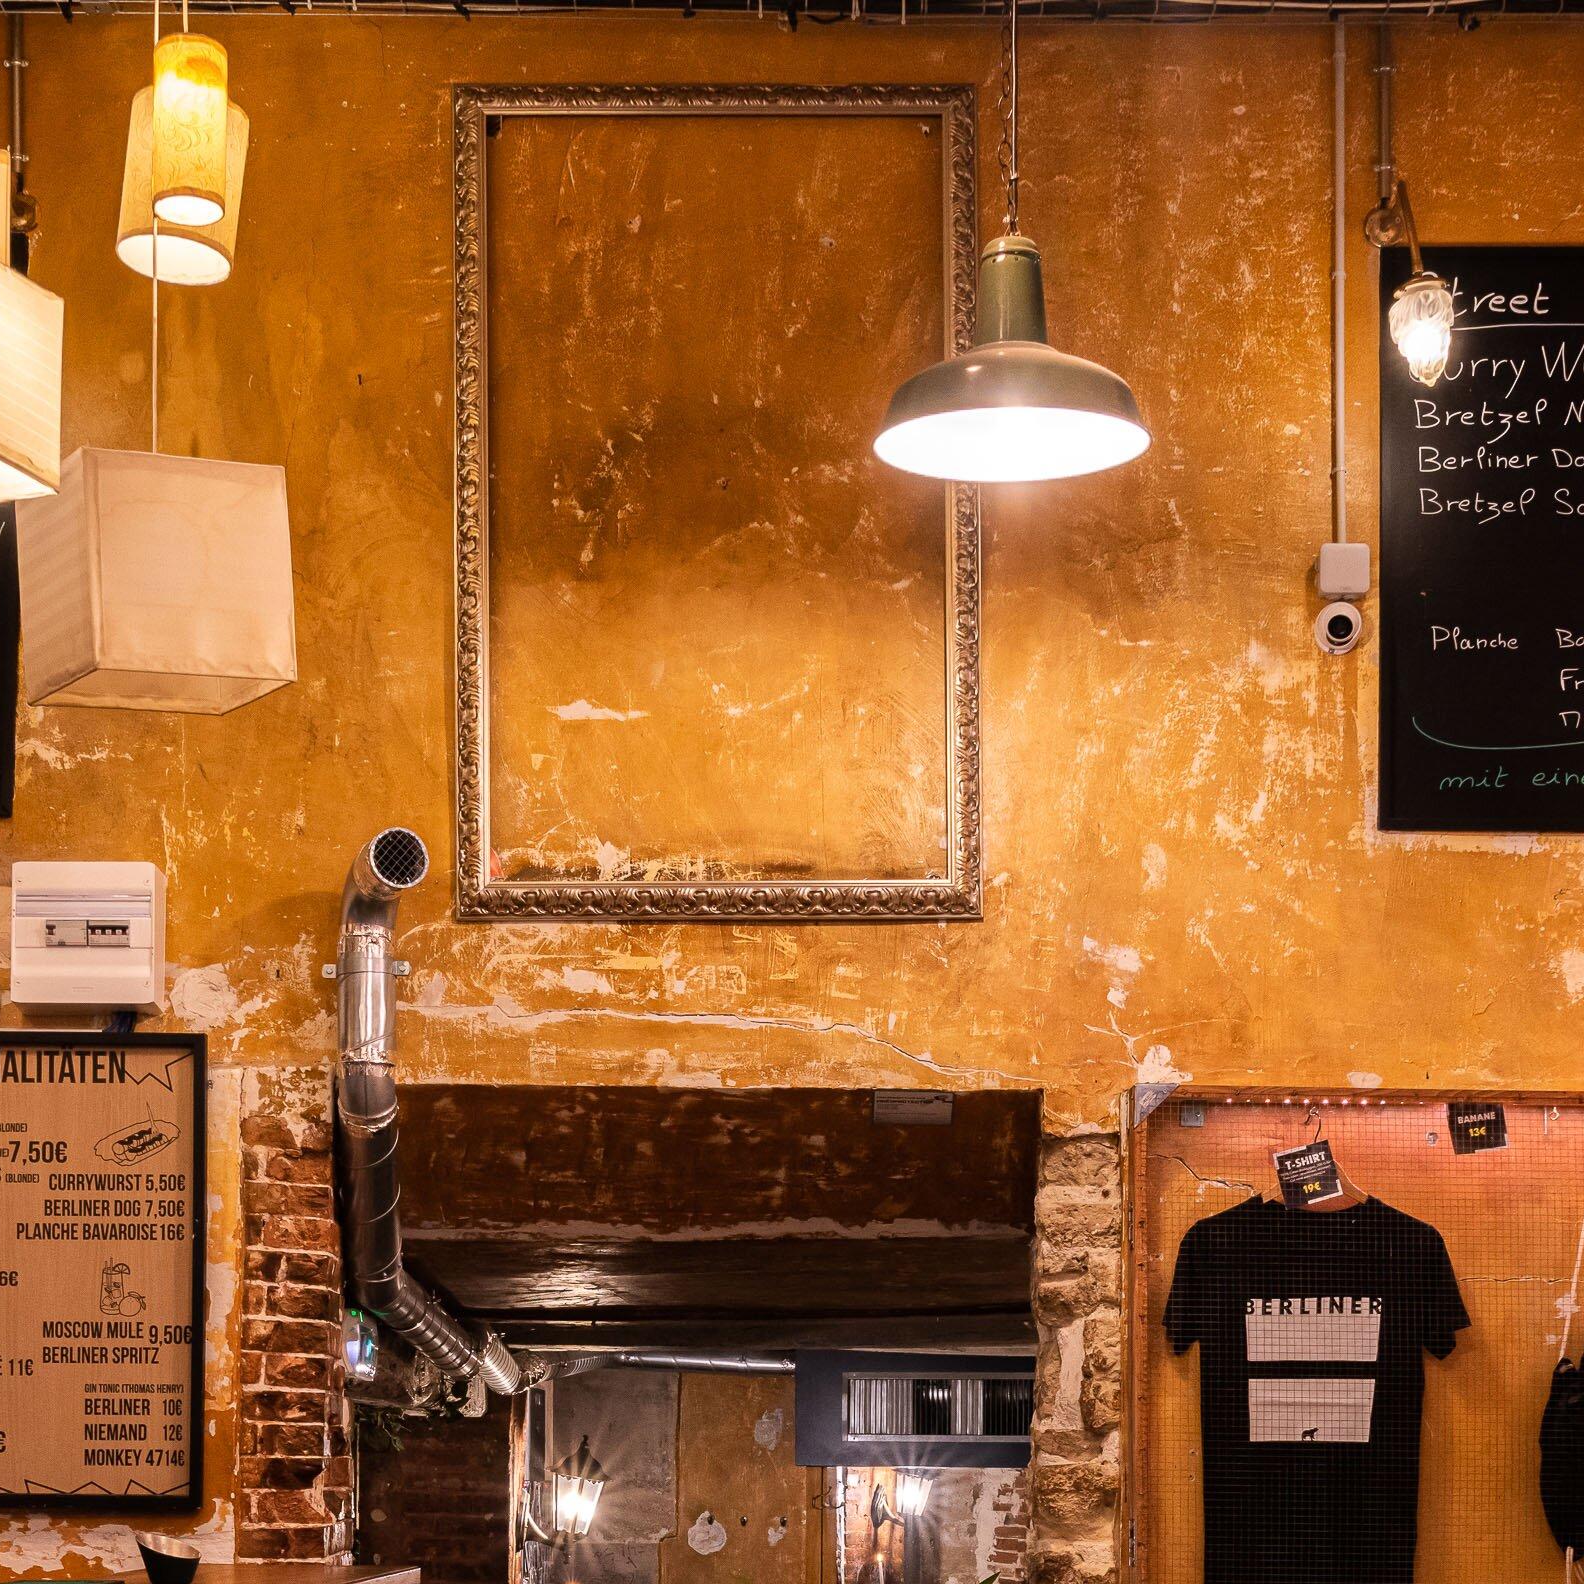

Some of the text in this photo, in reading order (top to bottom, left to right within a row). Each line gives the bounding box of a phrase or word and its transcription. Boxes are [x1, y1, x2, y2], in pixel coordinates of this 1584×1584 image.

[1413, 397, 1548, 444] Bretzel
[1418, 443, 1541, 474] Berliner
[1418, 486, 1536, 524] Bretzel
[1430, 625, 1519, 653] Planche
[1439, 765, 1508, 792] mit
[1457, 1112, 1496, 1125] BANANE
[1469, 1126, 1487, 1137] 13€
[9, 1140, 68, 1166] 7,50€
[1284, 1151, 1326, 1170] T-SHIRT
[49, 1173, 186, 1194] CURRYWURST 5,50€
[1303, 1181, 1322, 1194] 19€
[44, 1200, 185, 1219] BERLINER DOG 7,50€
[16, 1223, 185, 1241] PLANCHE BAVAROISE 16€
[1245, 1296, 1382, 1315] BERLINER
[43, 1321, 193, 1347] MOSCOW MULE 9,50€
[43, 1347, 160, 1364] BERLINER SPRITZ
[8, 1358, 34, 1376] 11€
[84, 1383, 184, 1394] GIN TONIC (THOMAS HENRY)
[84, 1398, 183, 1416] BERLINER 10€
[84, 1423, 183, 1441] NIEMAND 12€
[84, 1449, 142, 1466] MONKEY
